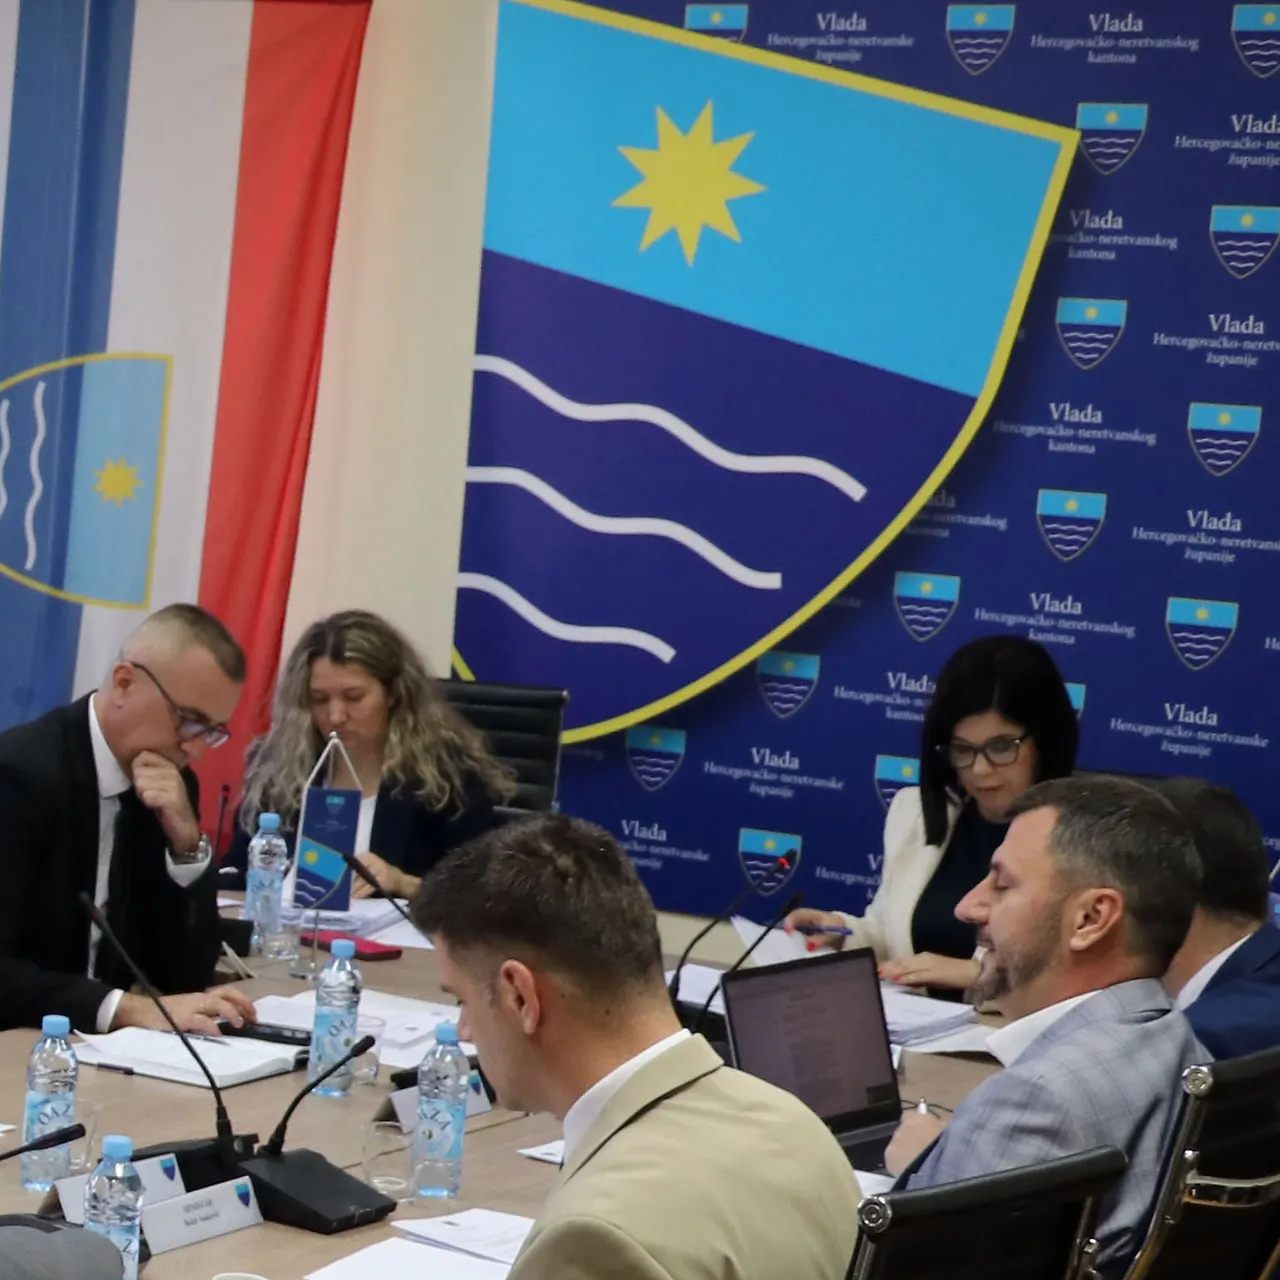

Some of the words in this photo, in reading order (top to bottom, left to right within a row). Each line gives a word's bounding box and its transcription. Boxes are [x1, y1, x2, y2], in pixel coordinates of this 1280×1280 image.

[816, 11, 867, 31] Vlada
[1089, 12, 1143, 32] Vlada
[1069, 209, 1123, 230] Vlada
[1209, 313, 1264, 334] Vlada
[1049, 403, 1103, 424] Vlada
[1186, 509, 1242, 531] Vlada
[1030, 593, 1082, 615] Vlada
[1164, 703, 1218, 726] Vlada
[751, 747, 800, 769] Vlada
[621, 819, 667, 841] Vlada
